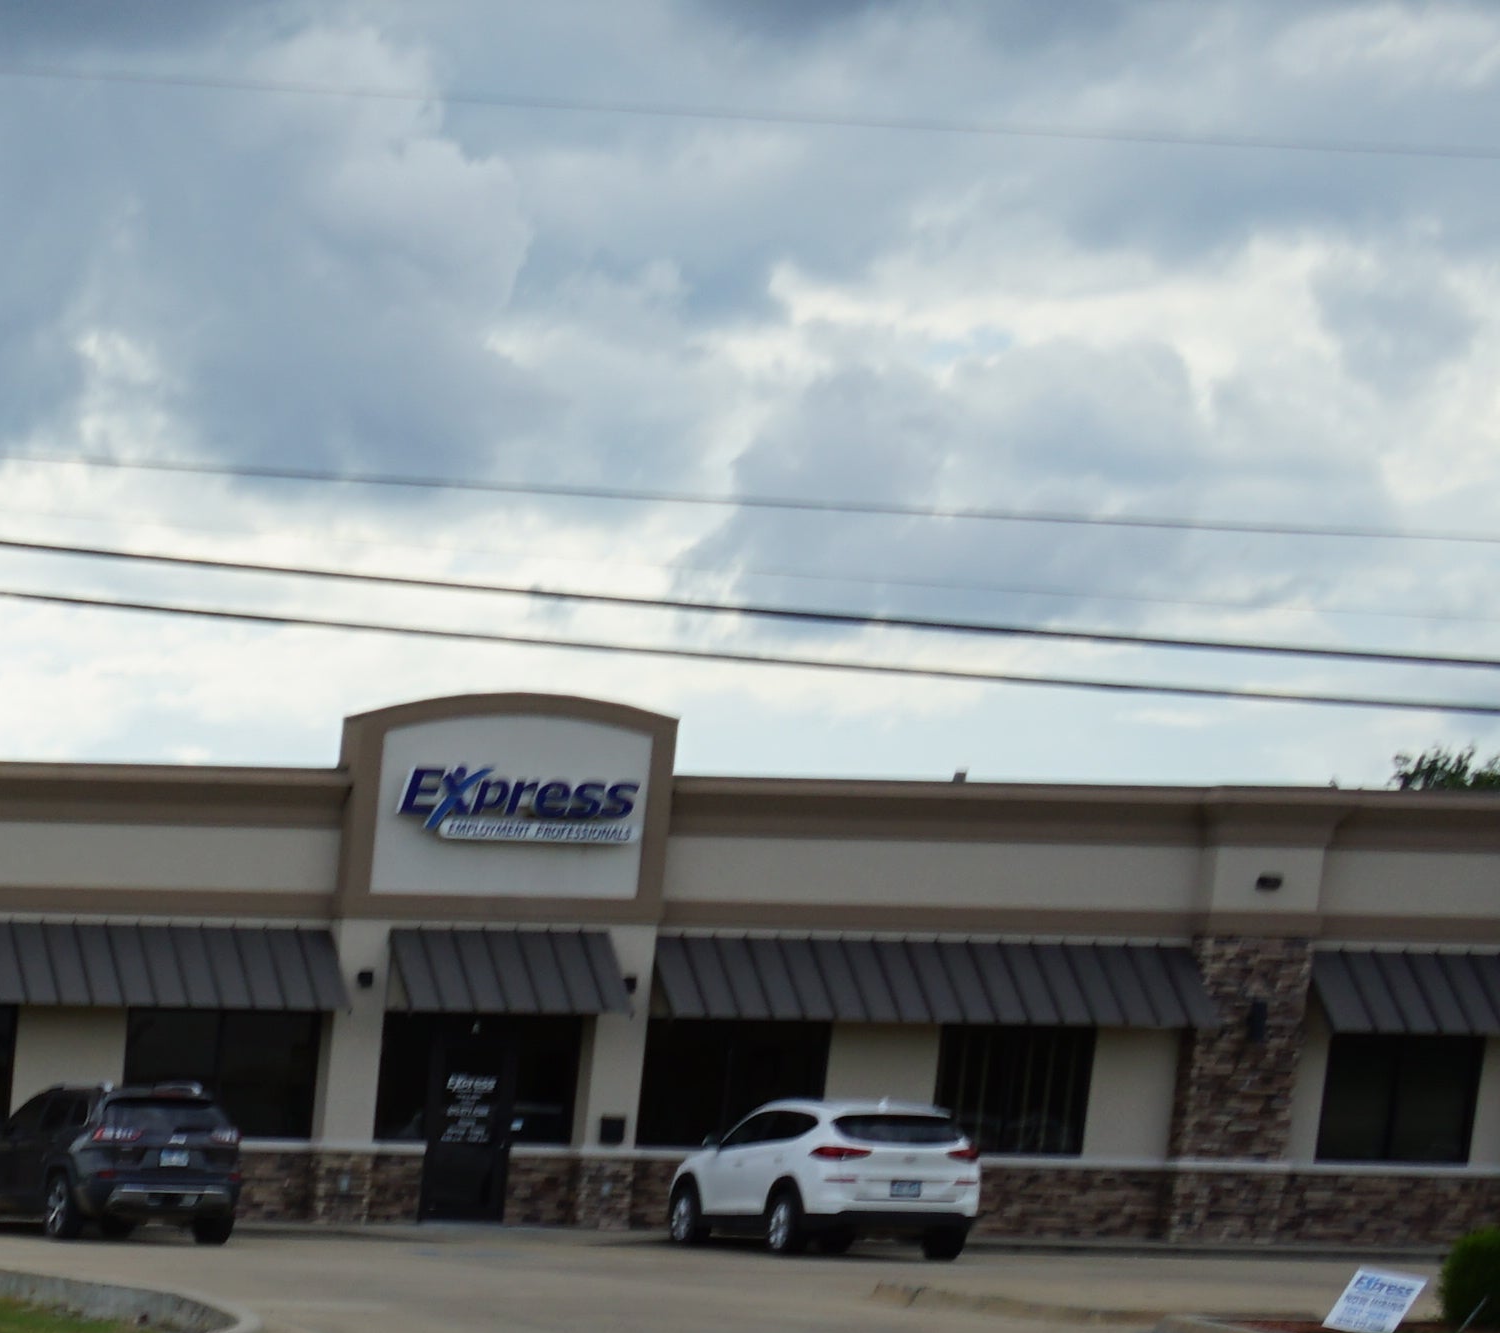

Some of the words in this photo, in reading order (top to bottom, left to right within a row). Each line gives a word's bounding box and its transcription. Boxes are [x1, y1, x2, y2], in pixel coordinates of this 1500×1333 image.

[397, 764, 641, 830] Express
[448, 820, 530, 838] EMPLOYMENT
[534, 822, 632, 841] PROFESSIONALS
